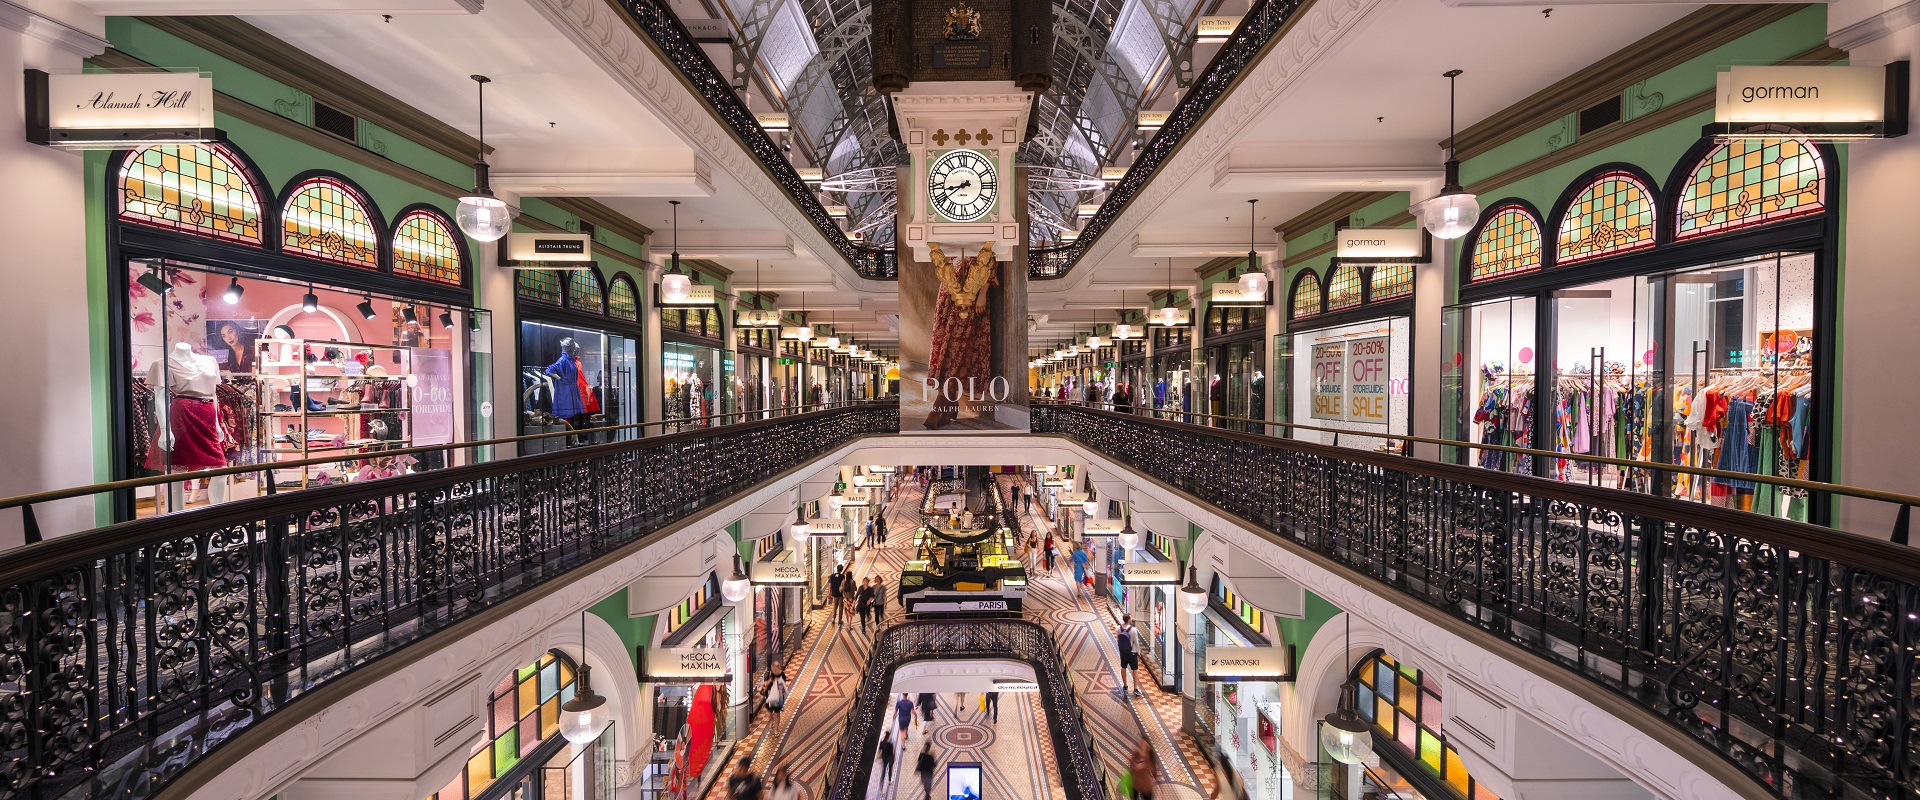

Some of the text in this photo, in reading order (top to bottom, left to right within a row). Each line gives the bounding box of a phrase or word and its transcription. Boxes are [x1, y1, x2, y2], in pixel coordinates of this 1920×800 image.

[77, 91, 191, 109] Alannah Hill
[1742, 86, 1819, 103] gorman
[1347, 239, 1385, 248] gorman
[1353, 341, 1384, 356] 20-50%
[1315, 362, 1341, 382] OFF
[1352, 358, 1384, 382] OFF
[922, 376, 1010, 402] POLO
[1353, 384, 1384, 394] STOREWIDE
[1315, 396, 1341, 415] SALE
[1352, 397, 1384, 418] SALE
[681, 653, 716, 661] MECCA
